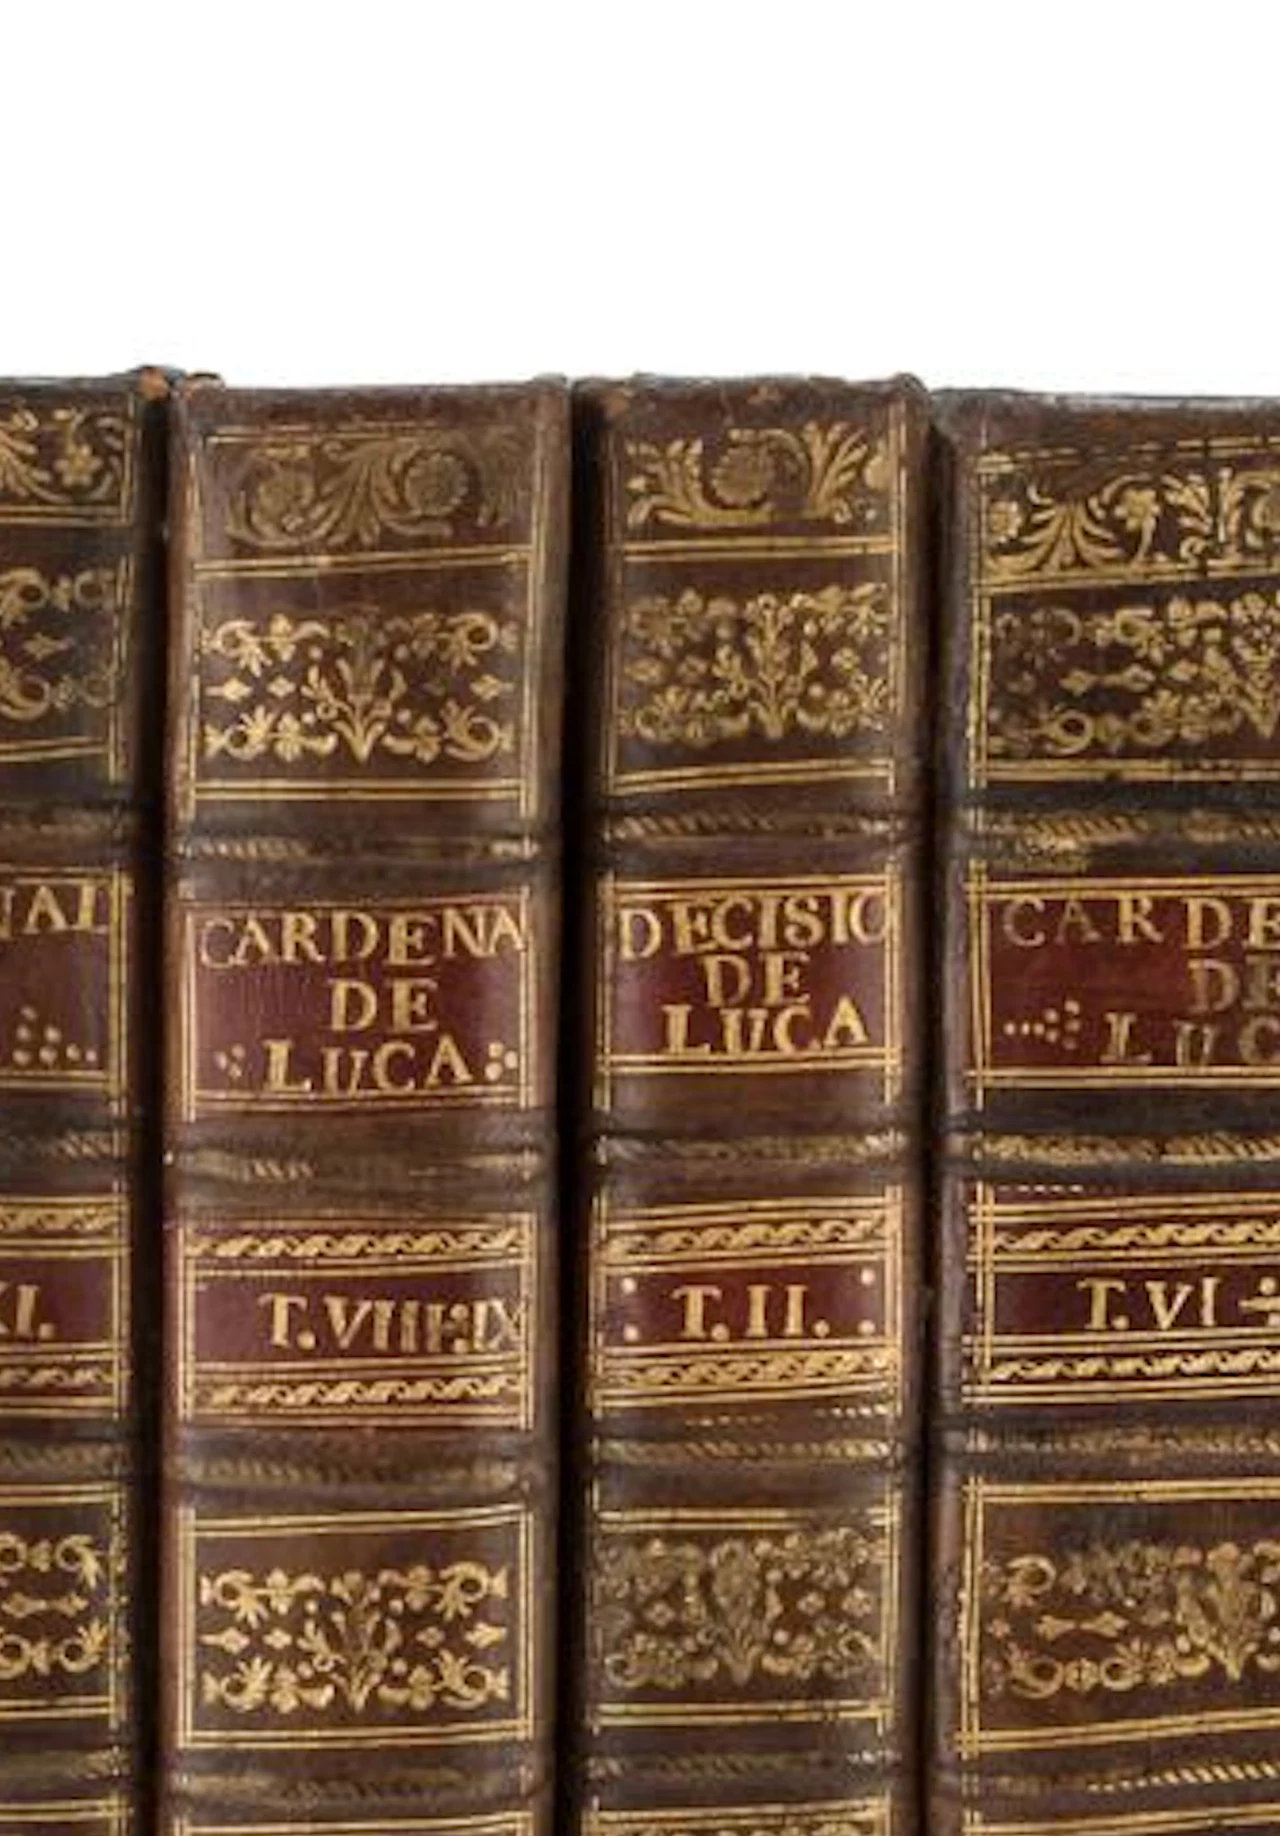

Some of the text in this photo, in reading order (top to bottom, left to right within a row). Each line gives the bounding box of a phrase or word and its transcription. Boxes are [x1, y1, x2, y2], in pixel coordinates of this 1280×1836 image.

[328, 978, 439, 1034] DE
[703, 950, 812, 1009] DE
[662, 998, 870, 1055] LUCA
[262, 1035, 472, 1097] LUCA
